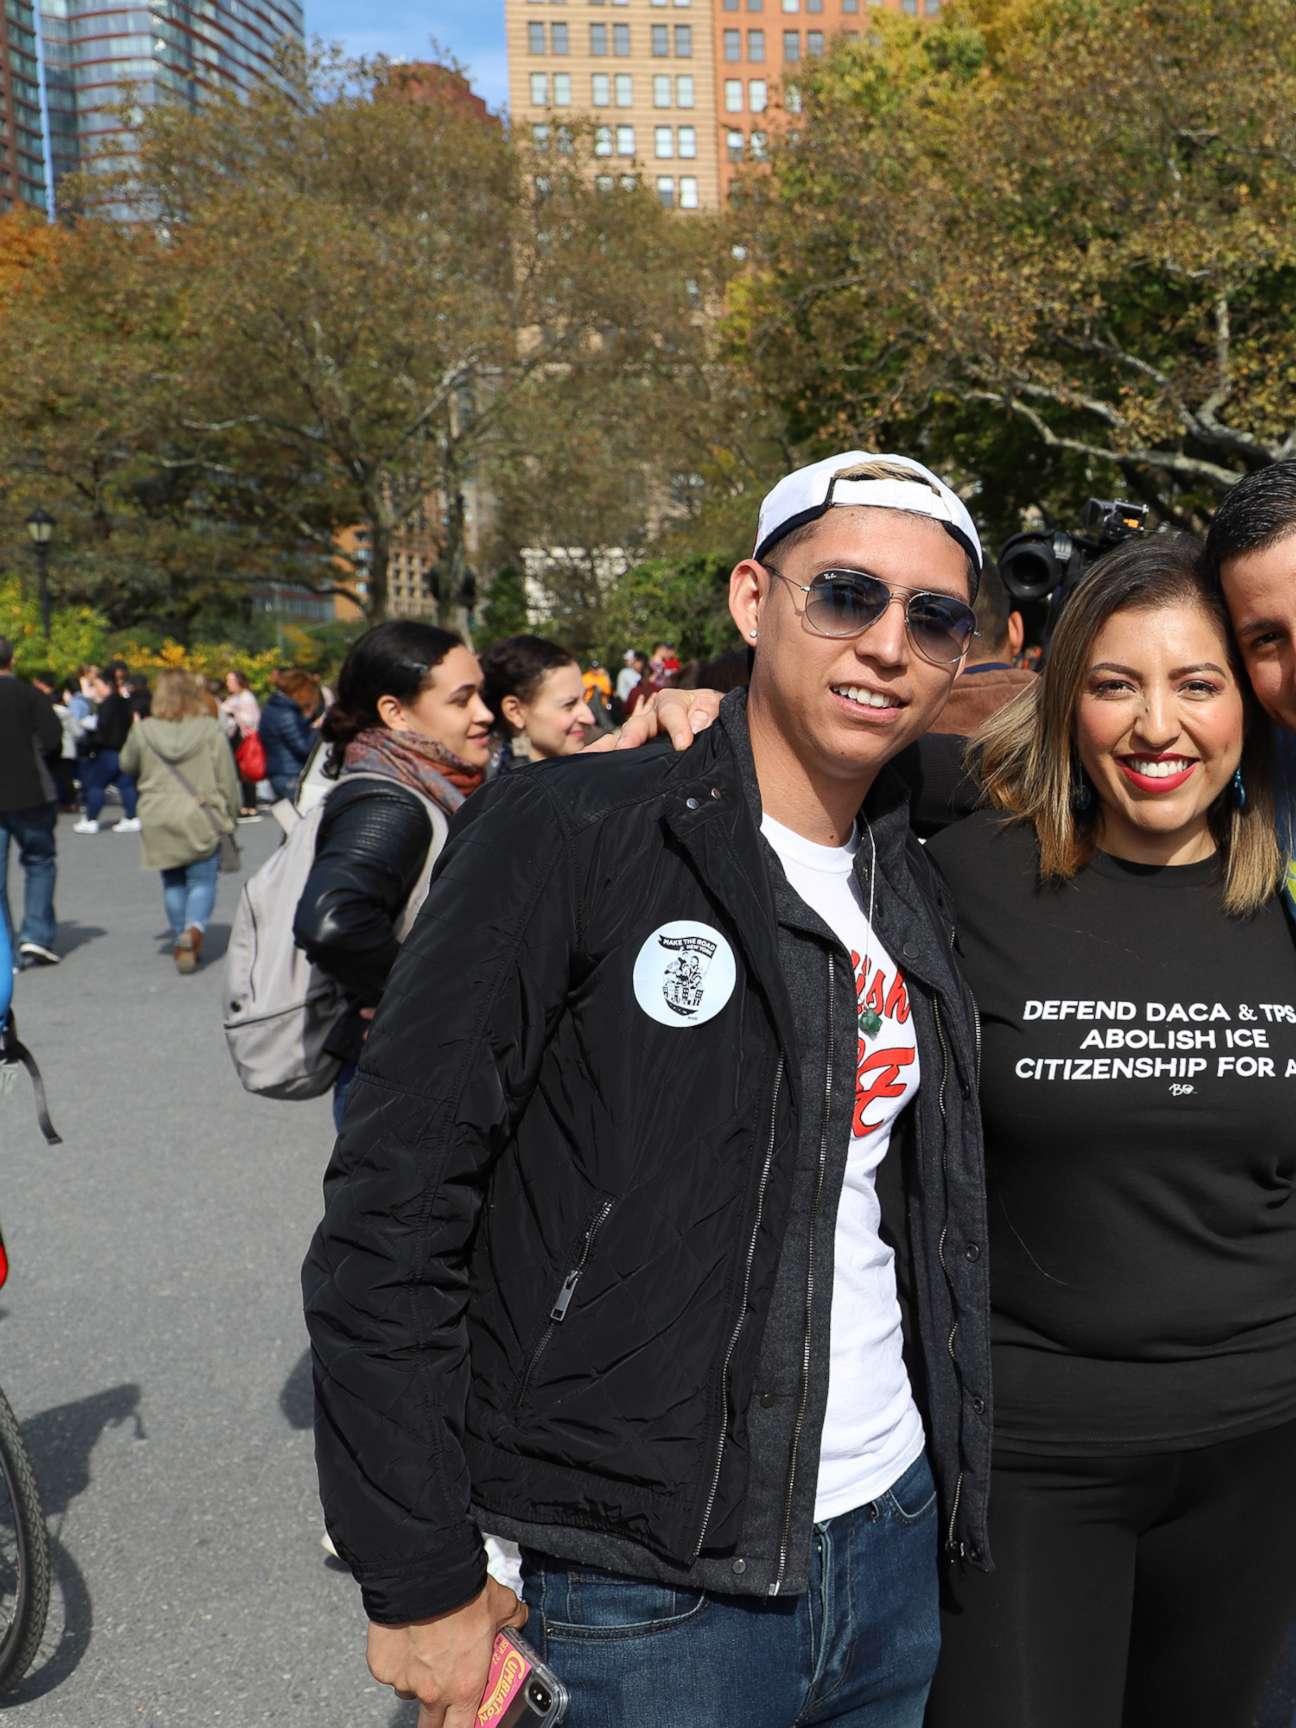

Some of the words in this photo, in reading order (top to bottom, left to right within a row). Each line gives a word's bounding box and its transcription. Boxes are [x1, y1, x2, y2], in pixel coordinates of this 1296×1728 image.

[663, 938, 682, 947] MAKE
[697, 939, 715, 951] ROAD
[1022, 1000, 1137, 1021] DEFEND
[1146, 1002, 1231, 1023] DACA
[1238, 1004, 1257, 1022] &
[1080, 1029, 1216, 1049] ABOLISH
[1225, 1028, 1270, 1049] ICE
[1015, 1058, 1207, 1080] CITIZENSHIP
[1217, 1056, 1275, 1078] FOR
